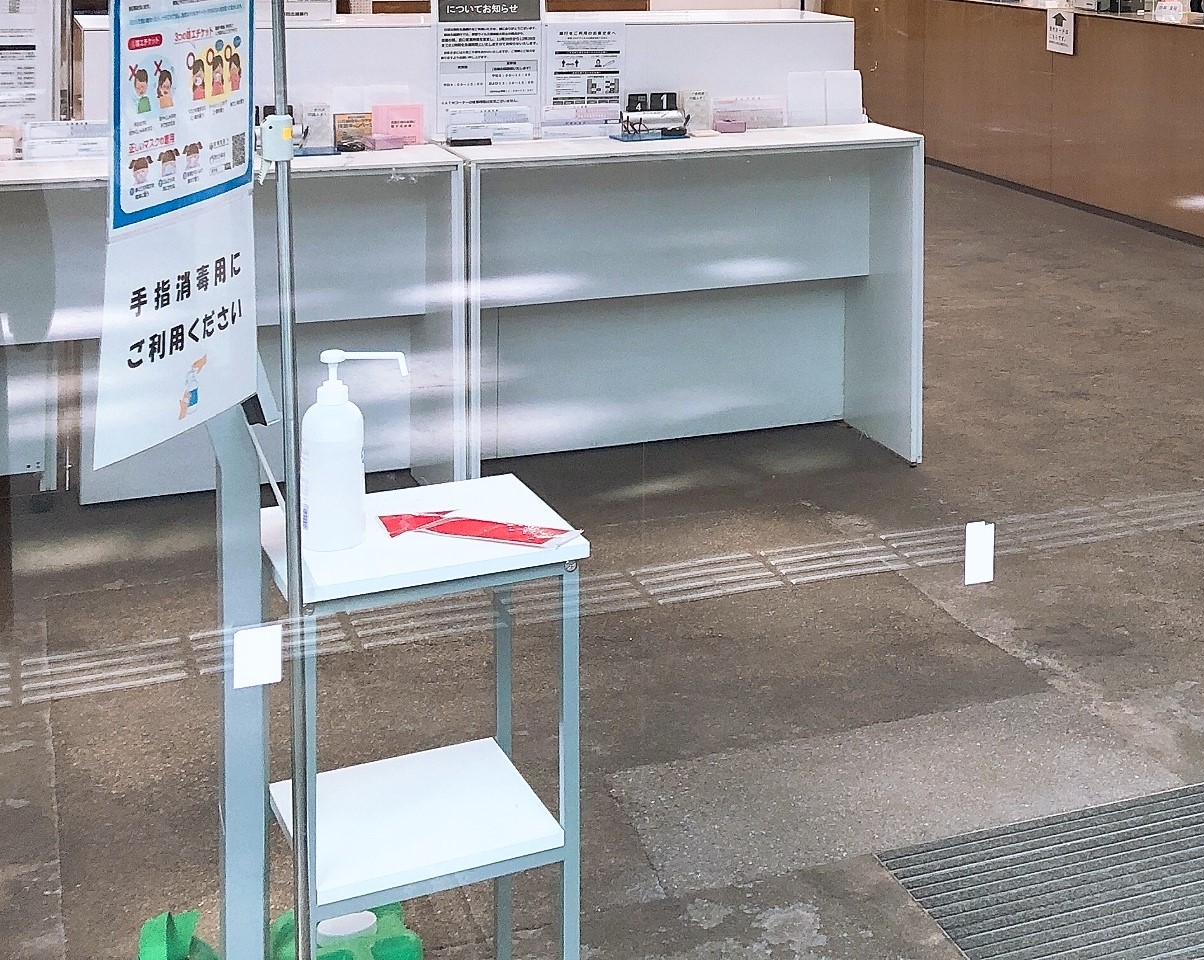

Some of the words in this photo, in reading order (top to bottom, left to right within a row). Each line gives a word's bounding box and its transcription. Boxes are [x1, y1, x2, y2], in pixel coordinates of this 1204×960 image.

[446, 4, 519, 14] についてお知らせ
[635, 102, 642, 111] 4
[660, 94, 667, 110] 1
[130, 251, 241, 318] 手指消毒用に
[127, 299, 242, 369] ご利用ください
